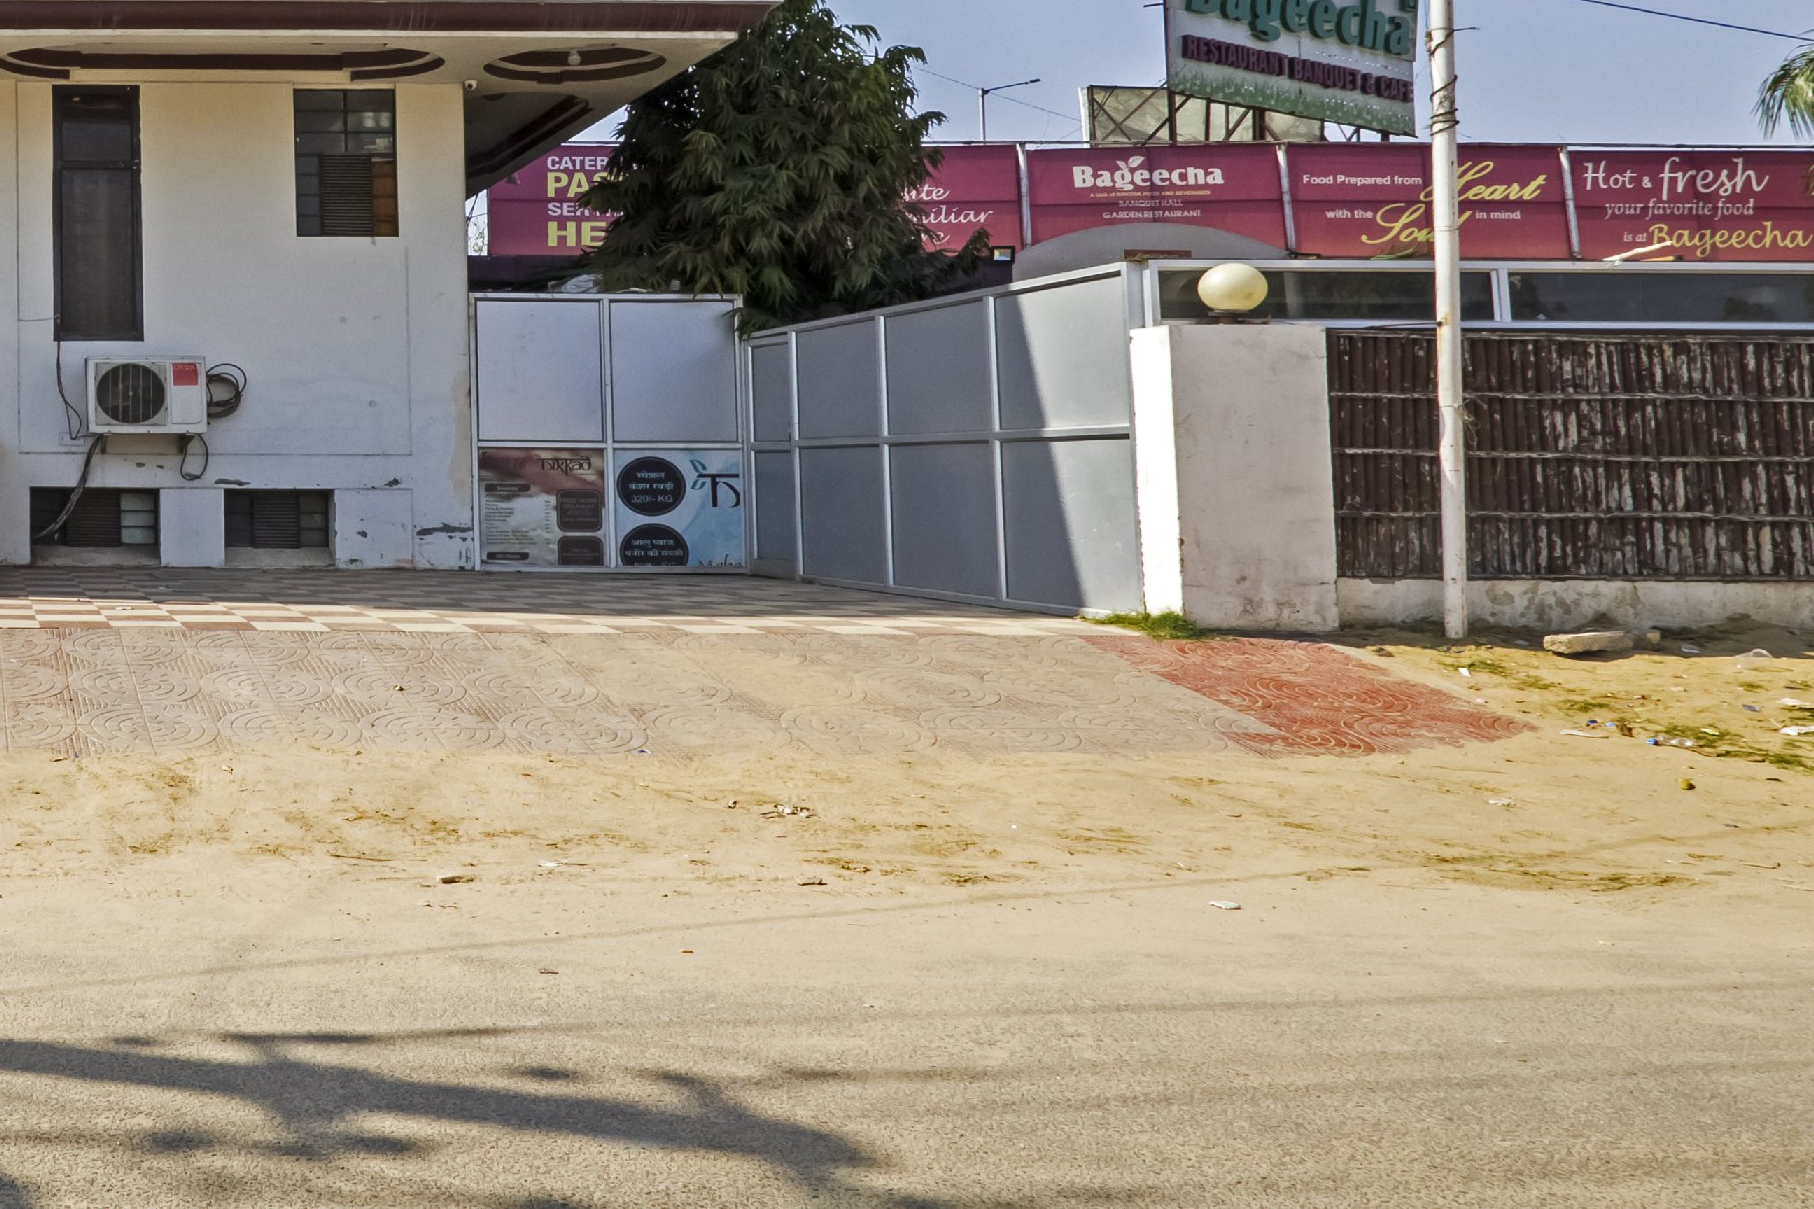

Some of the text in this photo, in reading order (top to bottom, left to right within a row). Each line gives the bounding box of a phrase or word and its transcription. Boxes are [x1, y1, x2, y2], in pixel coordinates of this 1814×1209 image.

[1181, 34, 1289, 78] RESTAURANT
[1288, 56, 1361, 92] BANQUET
[1374, 76, 1414, 104] CAFE
[547, 156, 610, 170] CATER
[1072, 166, 1225, 191] Bageecha
[1303, 174, 1333, 185] Food
[1337, 174, 1391, 186] Prepared
[1394, 175, 1423, 186] from
[1583, 156, 1769, 201] Hot & fresh
[1119, 198, 1184, 207] BANQUET HALL
[1604, 198, 1755, 220] your favorite food
[1102, 209, 1202, 219] GARDEN RESTAURANT
[1325, 209, 1352, 219] with
[1354, 209, 1374, 219] the
[1475, 209, 1487, 220] in
[1490, 209, 1522, 220] mind
[547, 221, 607, 247] HE
[1623, 221, 1814, 257] is at Bageecha
[657, 494, 673, 503] KG
